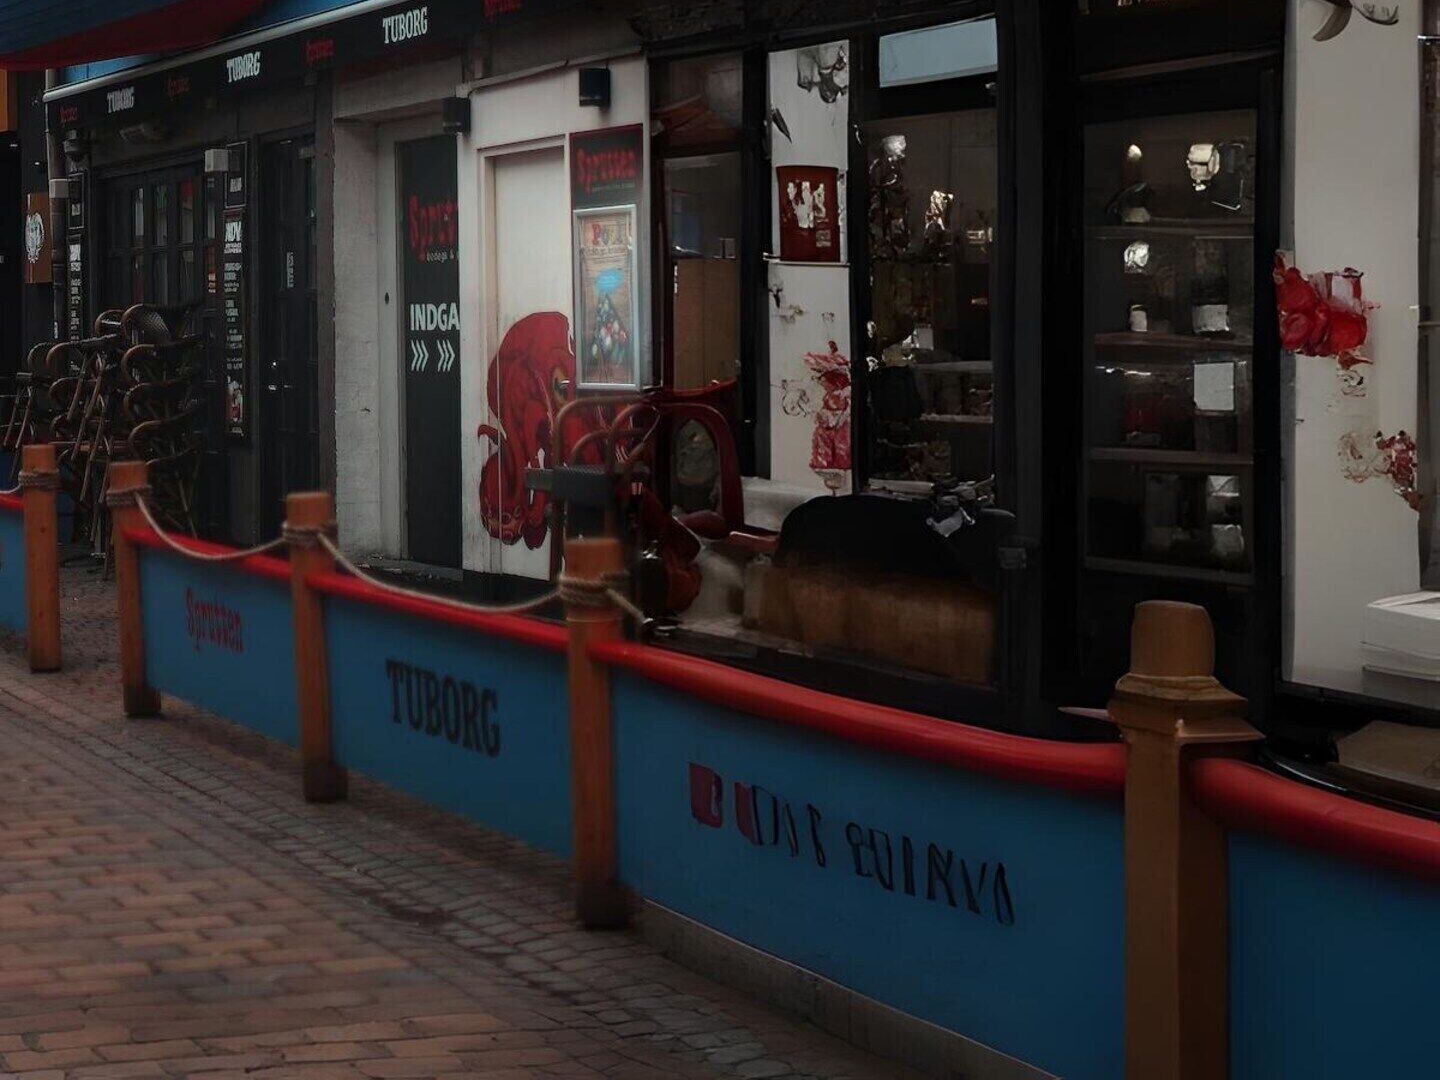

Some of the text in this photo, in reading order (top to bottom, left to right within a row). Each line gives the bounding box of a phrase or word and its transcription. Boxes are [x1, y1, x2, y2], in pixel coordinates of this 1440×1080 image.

[382, 6, 428, 44] TUBORG
[225, 51, 261, 83] TUBORG
[106, 86, 135, 115] TUBORG
[385, 658, 502, 758] TUBORG
